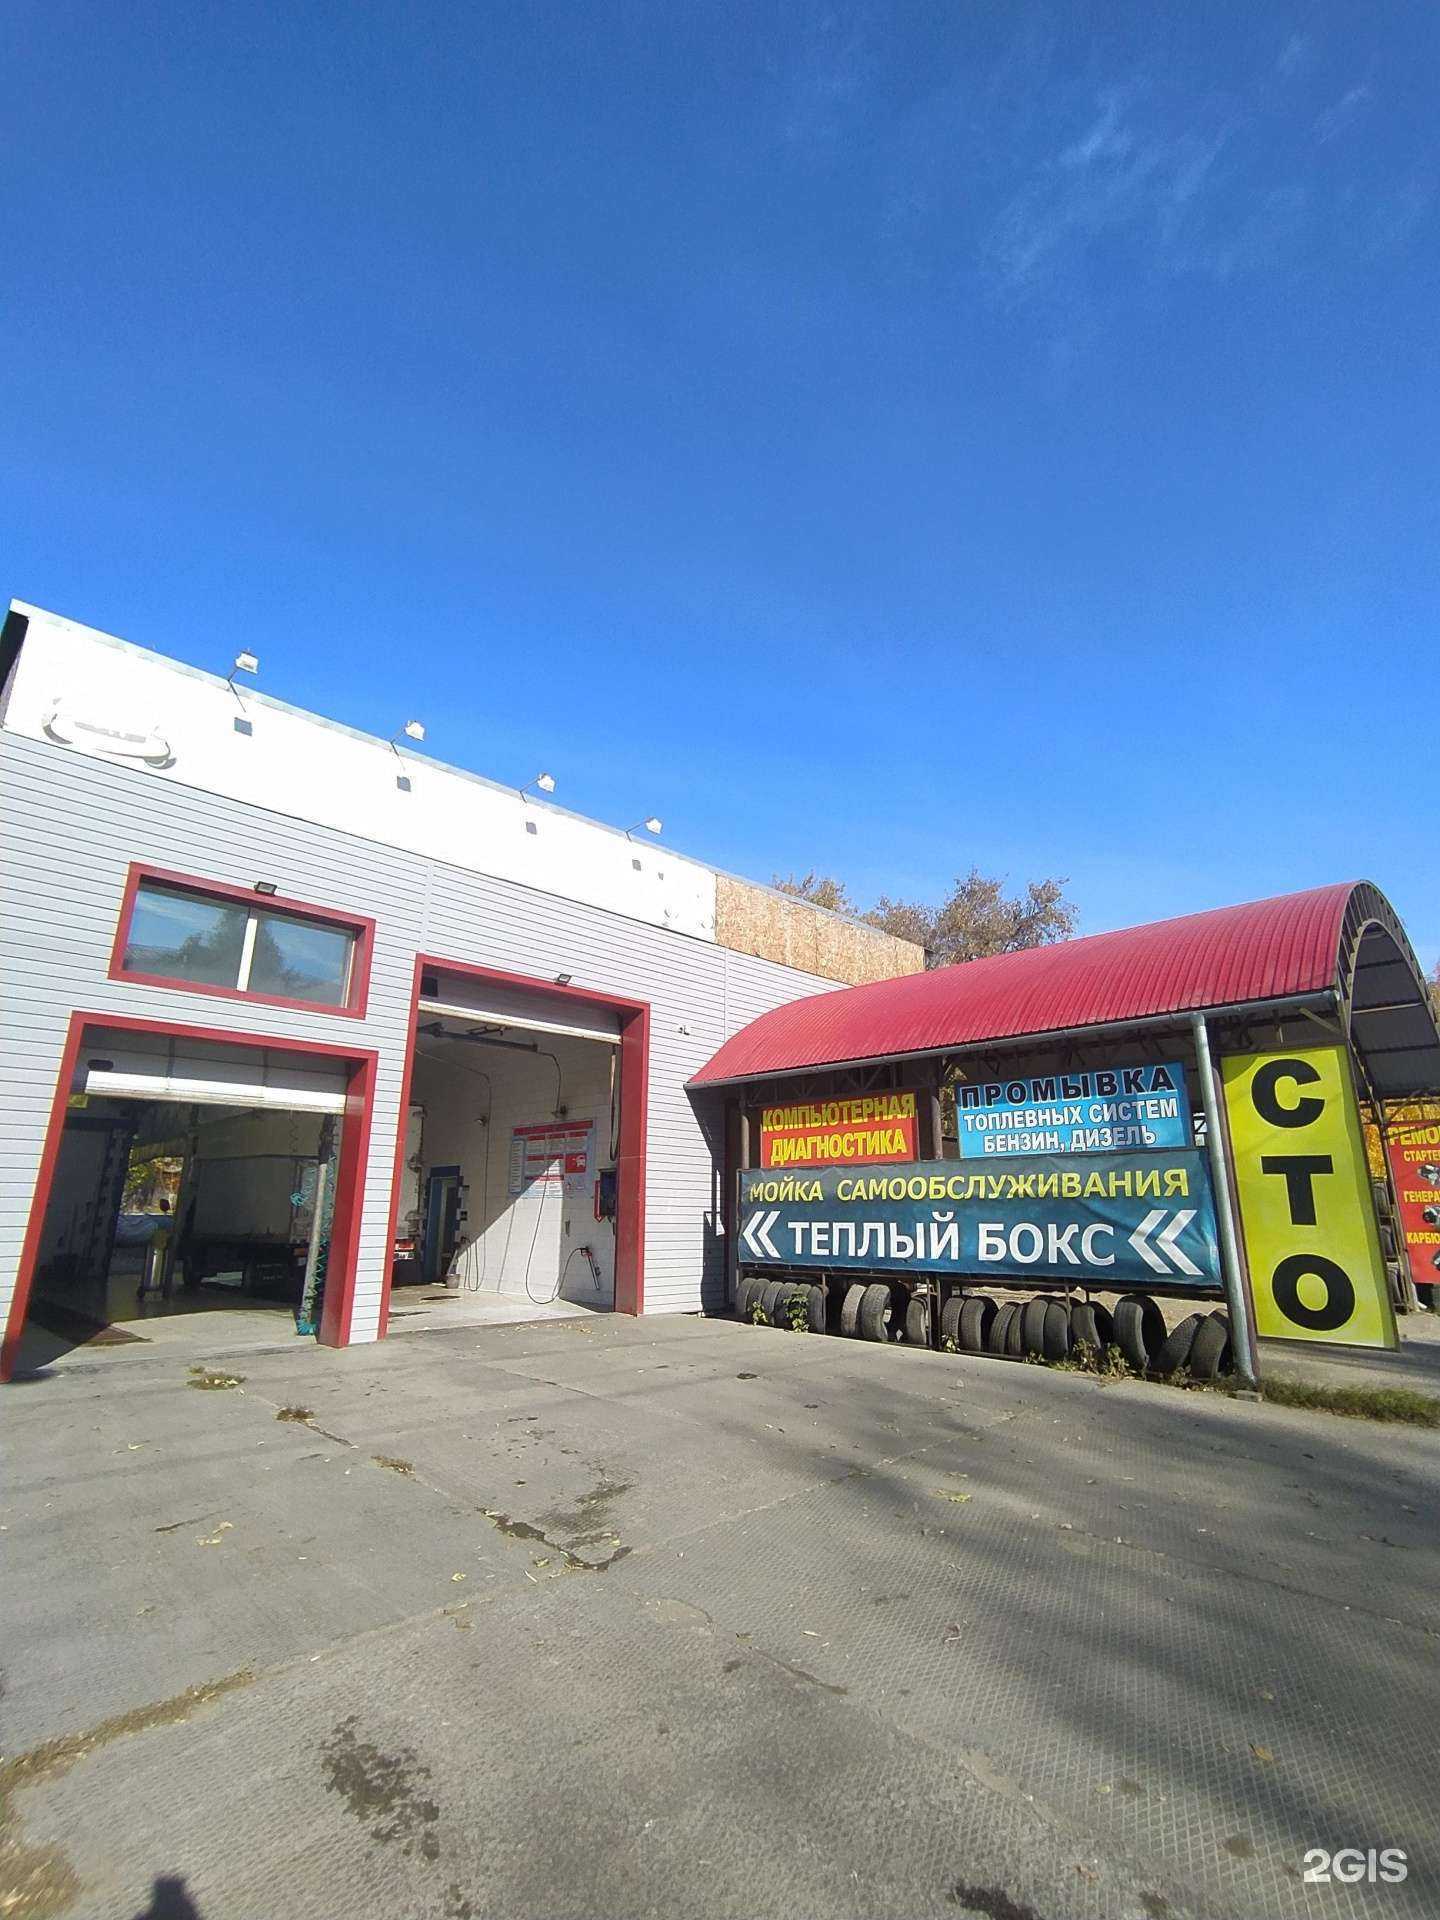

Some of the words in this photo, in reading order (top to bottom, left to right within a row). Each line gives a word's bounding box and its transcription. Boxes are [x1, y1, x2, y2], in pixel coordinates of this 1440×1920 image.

[960, 1066, 1178, 1110] ПРОМЫВКА
[762, 1093, 915, 1132] КОМПЬЮТЕРНАЯ
[963, 1105, 1084, 1132] ТОПЛЕВНЫХ
[1089, 1098, 1178, 1122] СИСТЕМ
[771, 1129, 907, 1166] ДИАГНОСТИКА
[984, 1131, 1065, 1153] БЕНЗИН,
[1070, 1125, 1156, 1152] ДИЗЕЛЬ
[1388, 1125, 1440, 1146] РЕМО
[1403, 1149, 1440, 1162] СТАРТЕ
[750, 1176, 824, 1202] МОЙКА
[837, 1169, 1189, 1200] САМООБСЛУЖИВАНИЯ
[1251, 1058, 1356, 1332] СТО
[1403, 1190, 1440, 1203] ГЕНЕРА
[788, 1211, 959, 1260] ТЕПЛЫЙ
[978, 1223, 1115, 1266] БОКС
[1406, 1232, 1440, 1245] КАРБЮ
